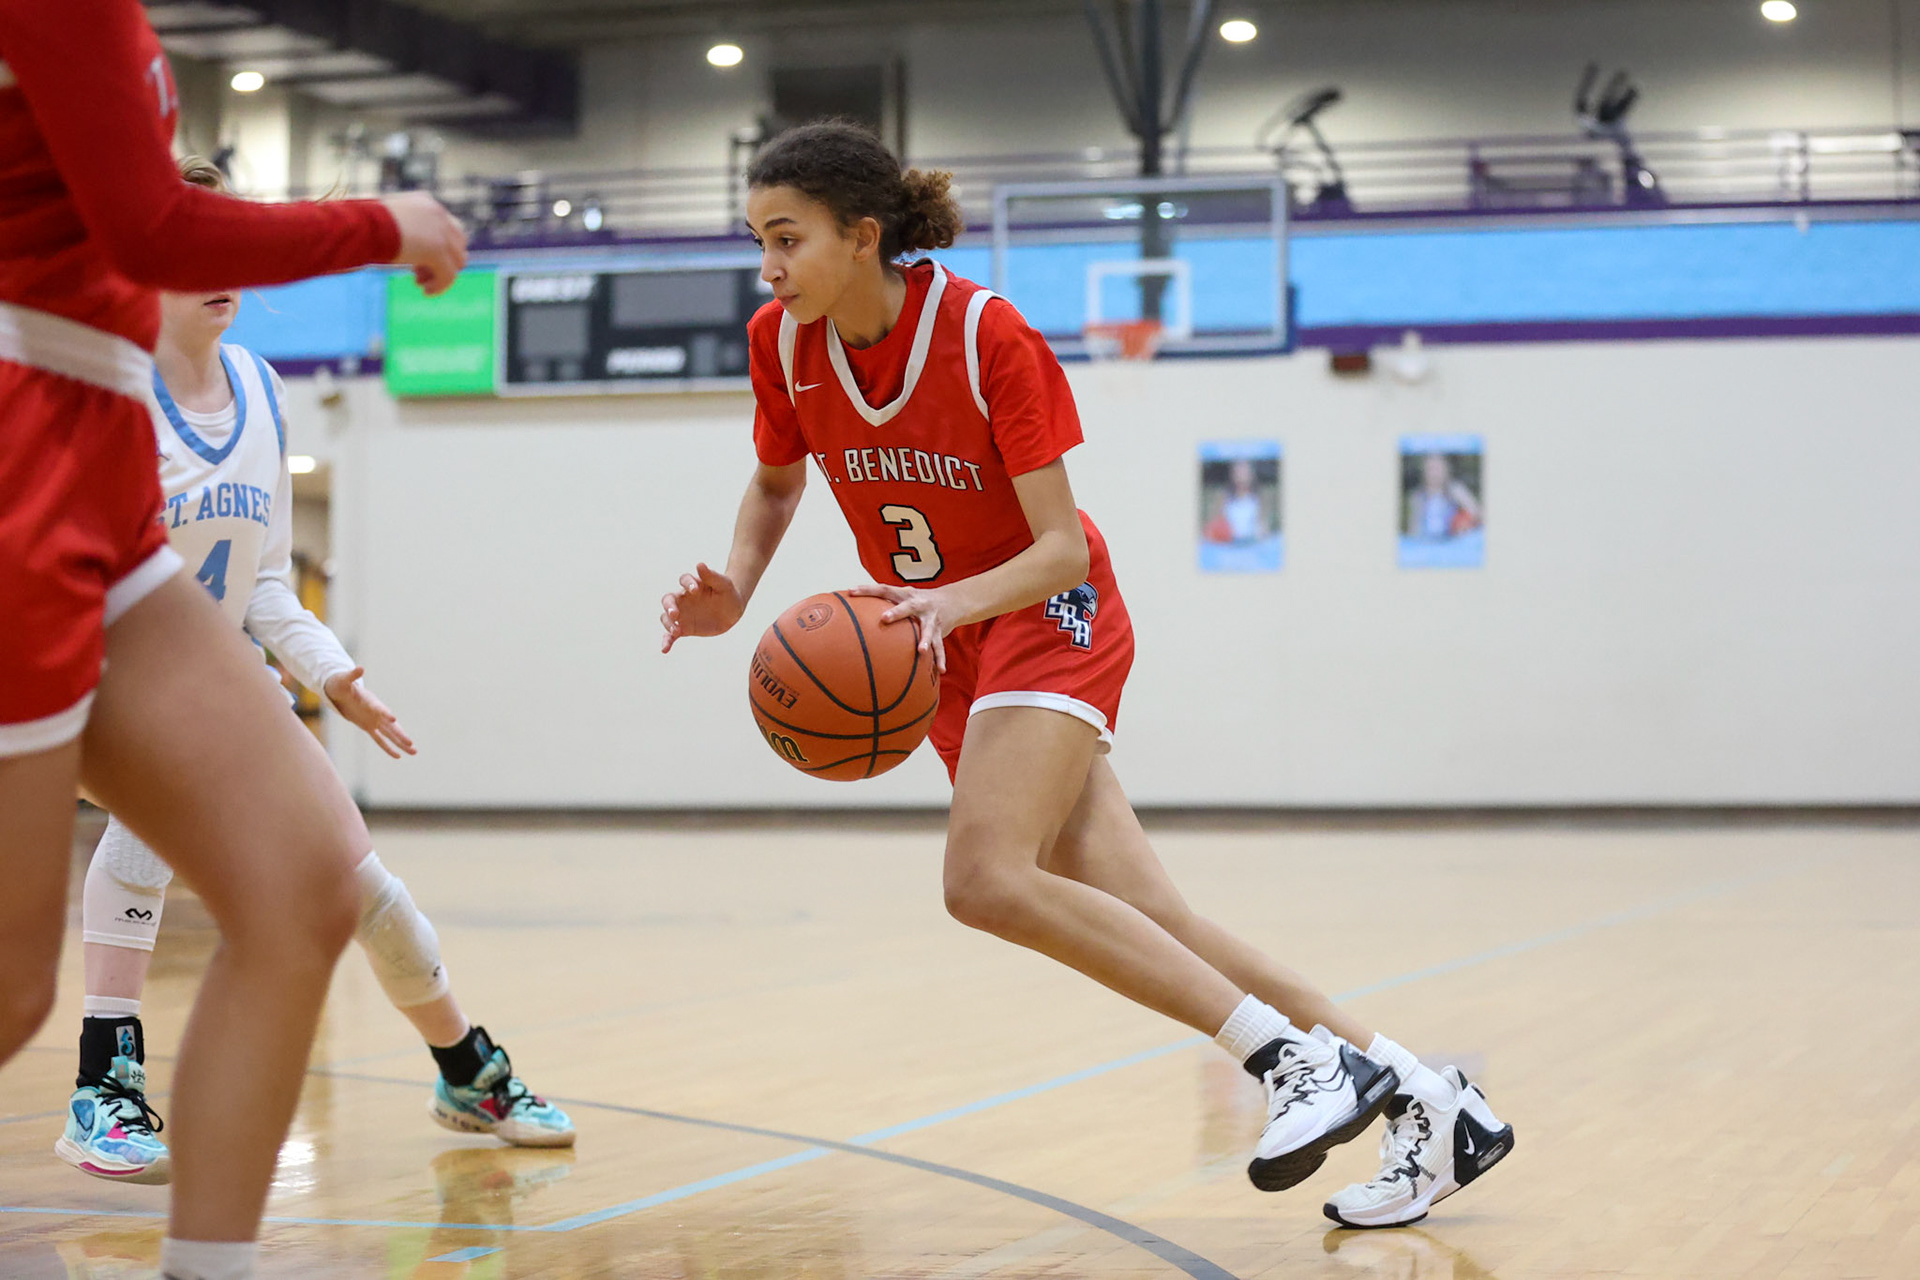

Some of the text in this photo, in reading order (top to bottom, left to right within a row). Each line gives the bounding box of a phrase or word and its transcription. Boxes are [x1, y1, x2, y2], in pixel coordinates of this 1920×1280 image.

[843, 446, 985, 492] BENEDICT
[158, 482, 271, 529] T. AGNES
[879, 503, 944, 582] 3
